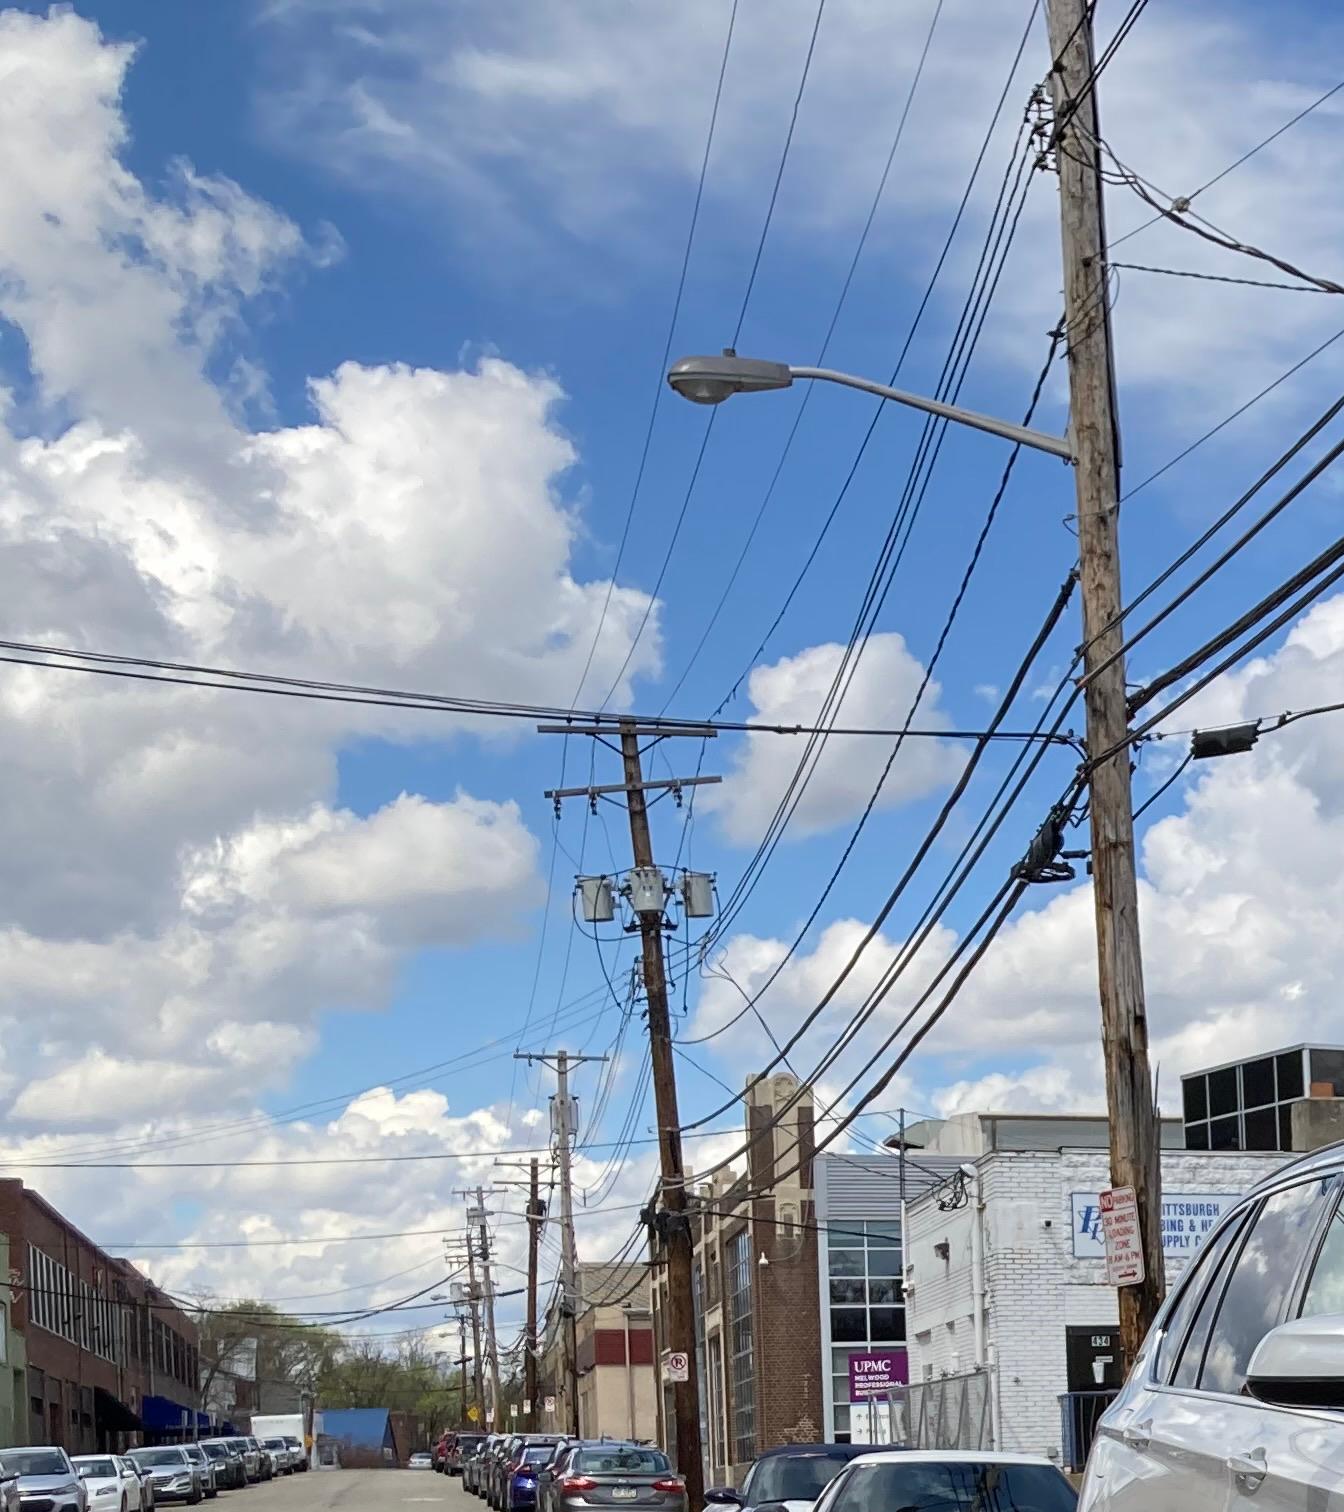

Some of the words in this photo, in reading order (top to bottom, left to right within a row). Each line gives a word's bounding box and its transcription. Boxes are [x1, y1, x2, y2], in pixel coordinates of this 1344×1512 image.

[1100, 1193, 1113, 1209] NO
[1161, 1203, 1220, 1216] ITTSBURGH
[1189, 1219, 1197, 1232] &
[1108, 1226, 1135, 1239] LOADING
[1114, 1239, 1131, 1250] ZONE
[1161, 1235, 1191, 1248] UPPLY
[854, 1360, 891, 1373] UPMC
